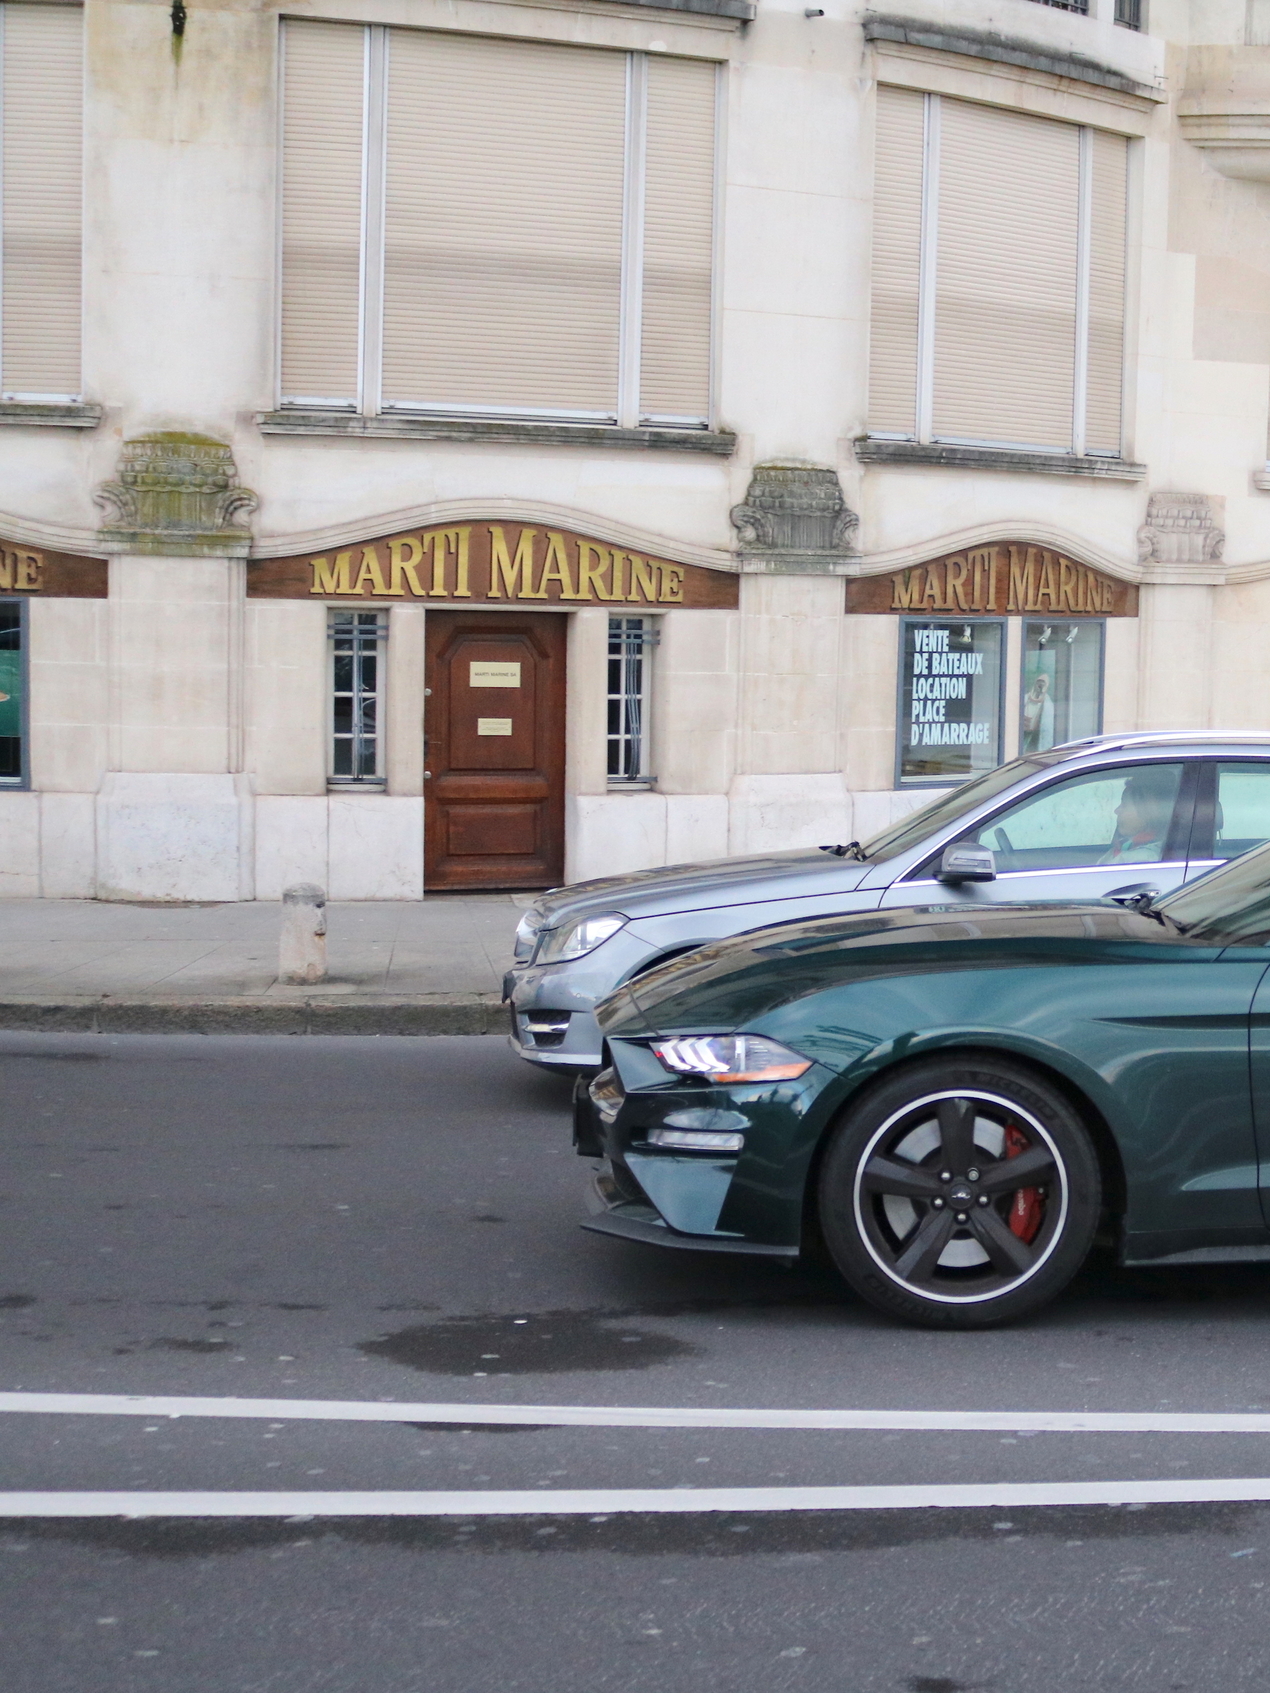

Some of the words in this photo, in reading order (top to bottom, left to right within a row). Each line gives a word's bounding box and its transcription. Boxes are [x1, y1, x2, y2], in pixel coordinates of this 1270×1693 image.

[309, 526, 472, 597] MARTI
[487, 526, 684, 603] MARINE
[890, 546, 999, 612] MARTI
[1005, 546, 1115, 613] MARINE
[914, 629, 949, 652] VENTE
[913, 653, 929, 675] DE
[932, 652, 984, 675] BATEAUX
[912, 677, 967, 699] LOCATION
[911, 700, 946, 722] PLACE
[911, 723, 990, 745] D'AMARRAGE
